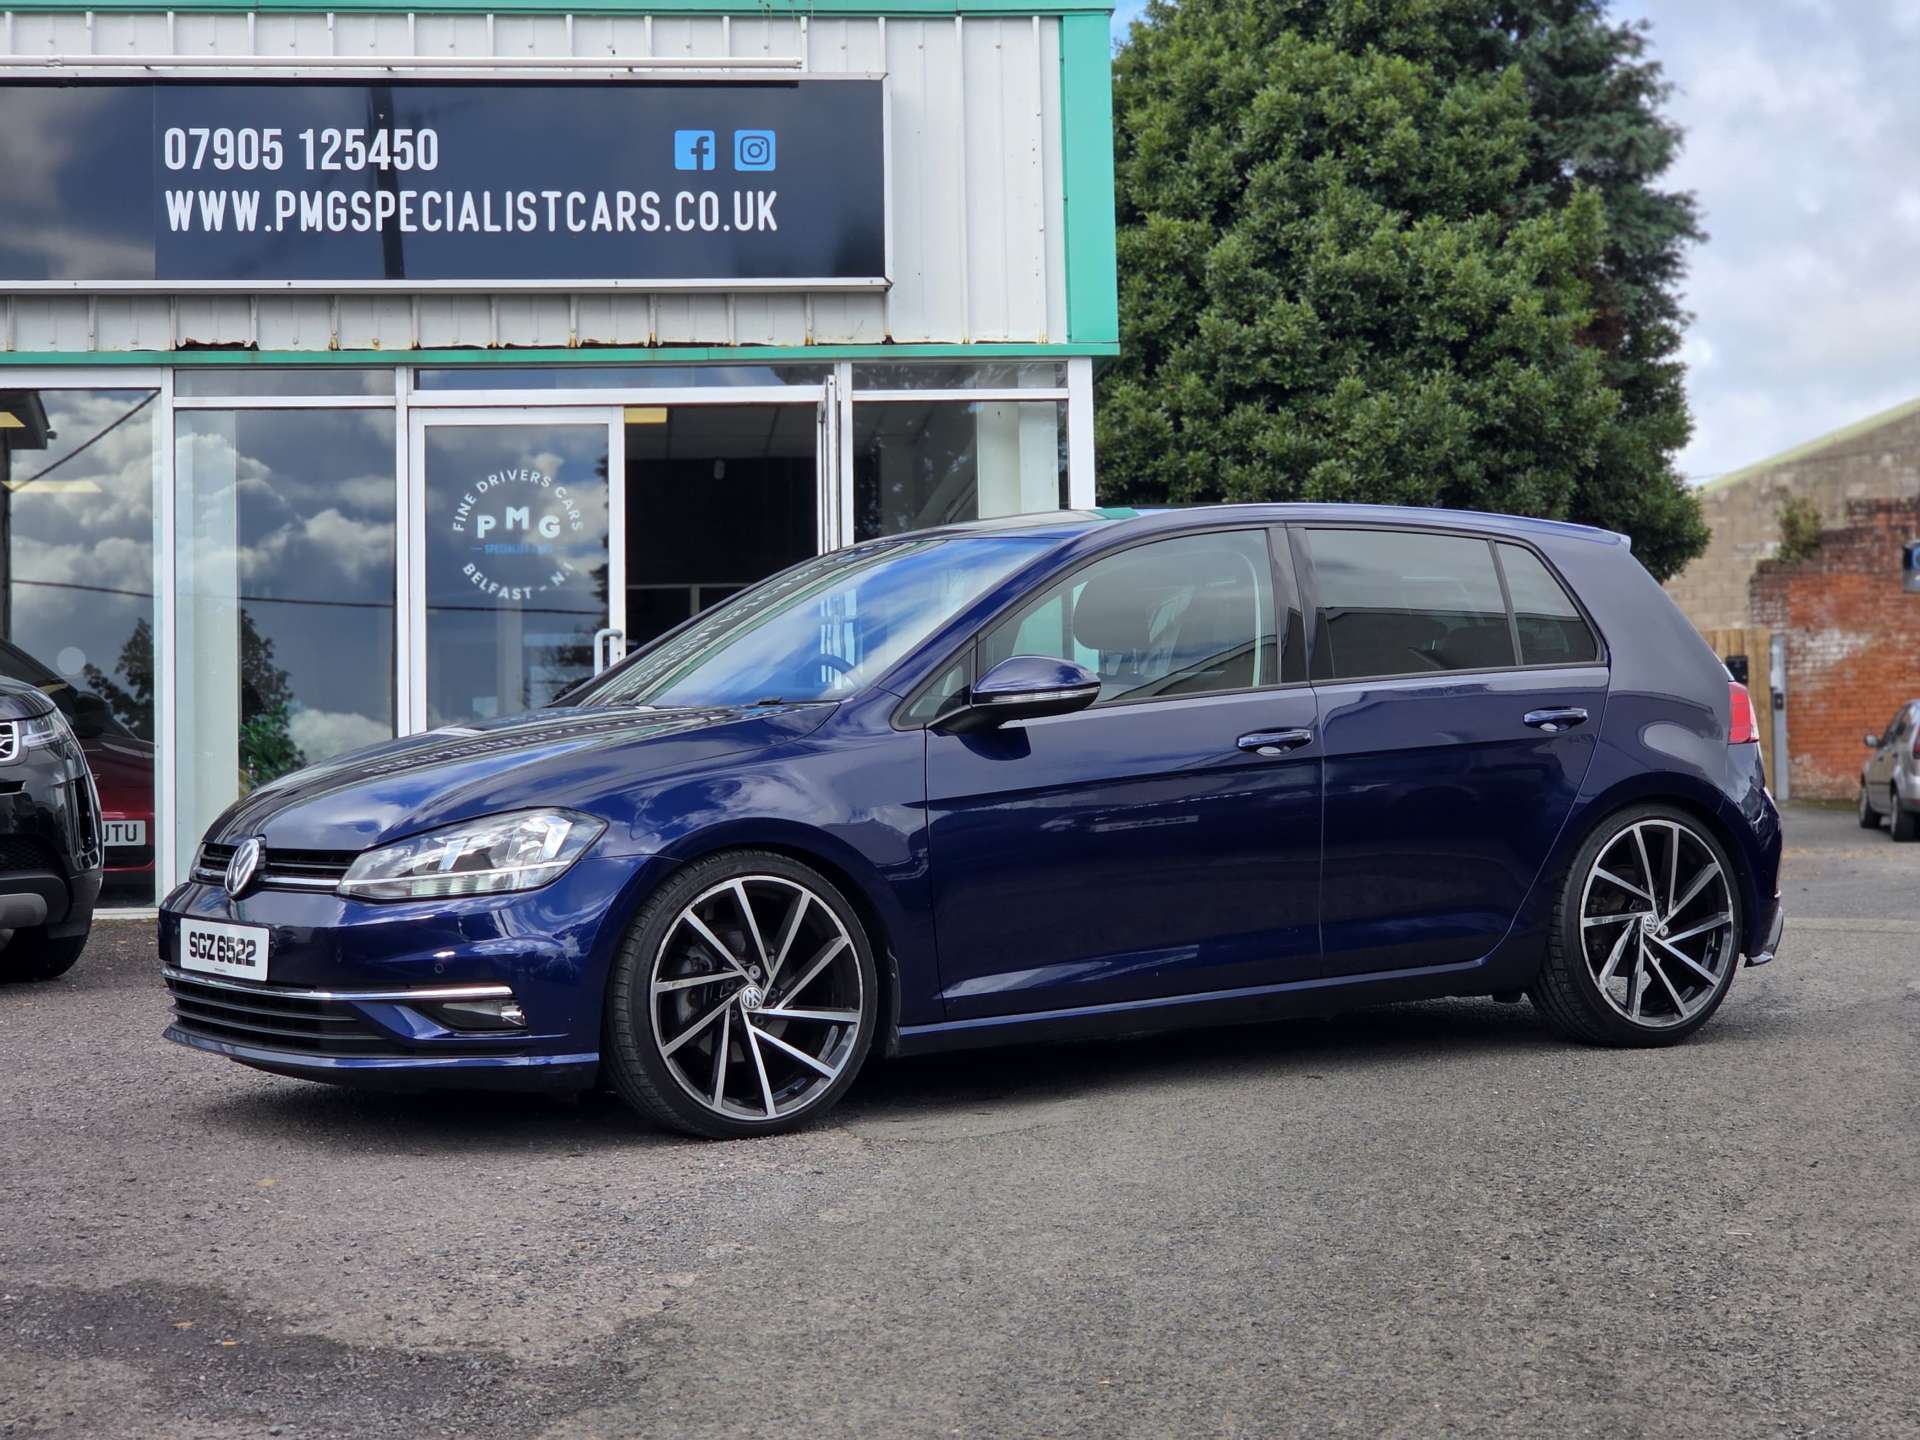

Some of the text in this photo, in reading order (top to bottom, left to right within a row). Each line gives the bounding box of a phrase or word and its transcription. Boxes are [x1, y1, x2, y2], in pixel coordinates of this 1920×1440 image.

[164, 127, 439, 170] 07905 125450
[165, 190, 778, 232] WWW.PMGSPECIALISTCARS.CO.UK
[452, 469, 583, 532] FINE DRIVERS CARS
[477, 506, 560, 539] PMG
[462, 562, 532, 600] BELFAST
